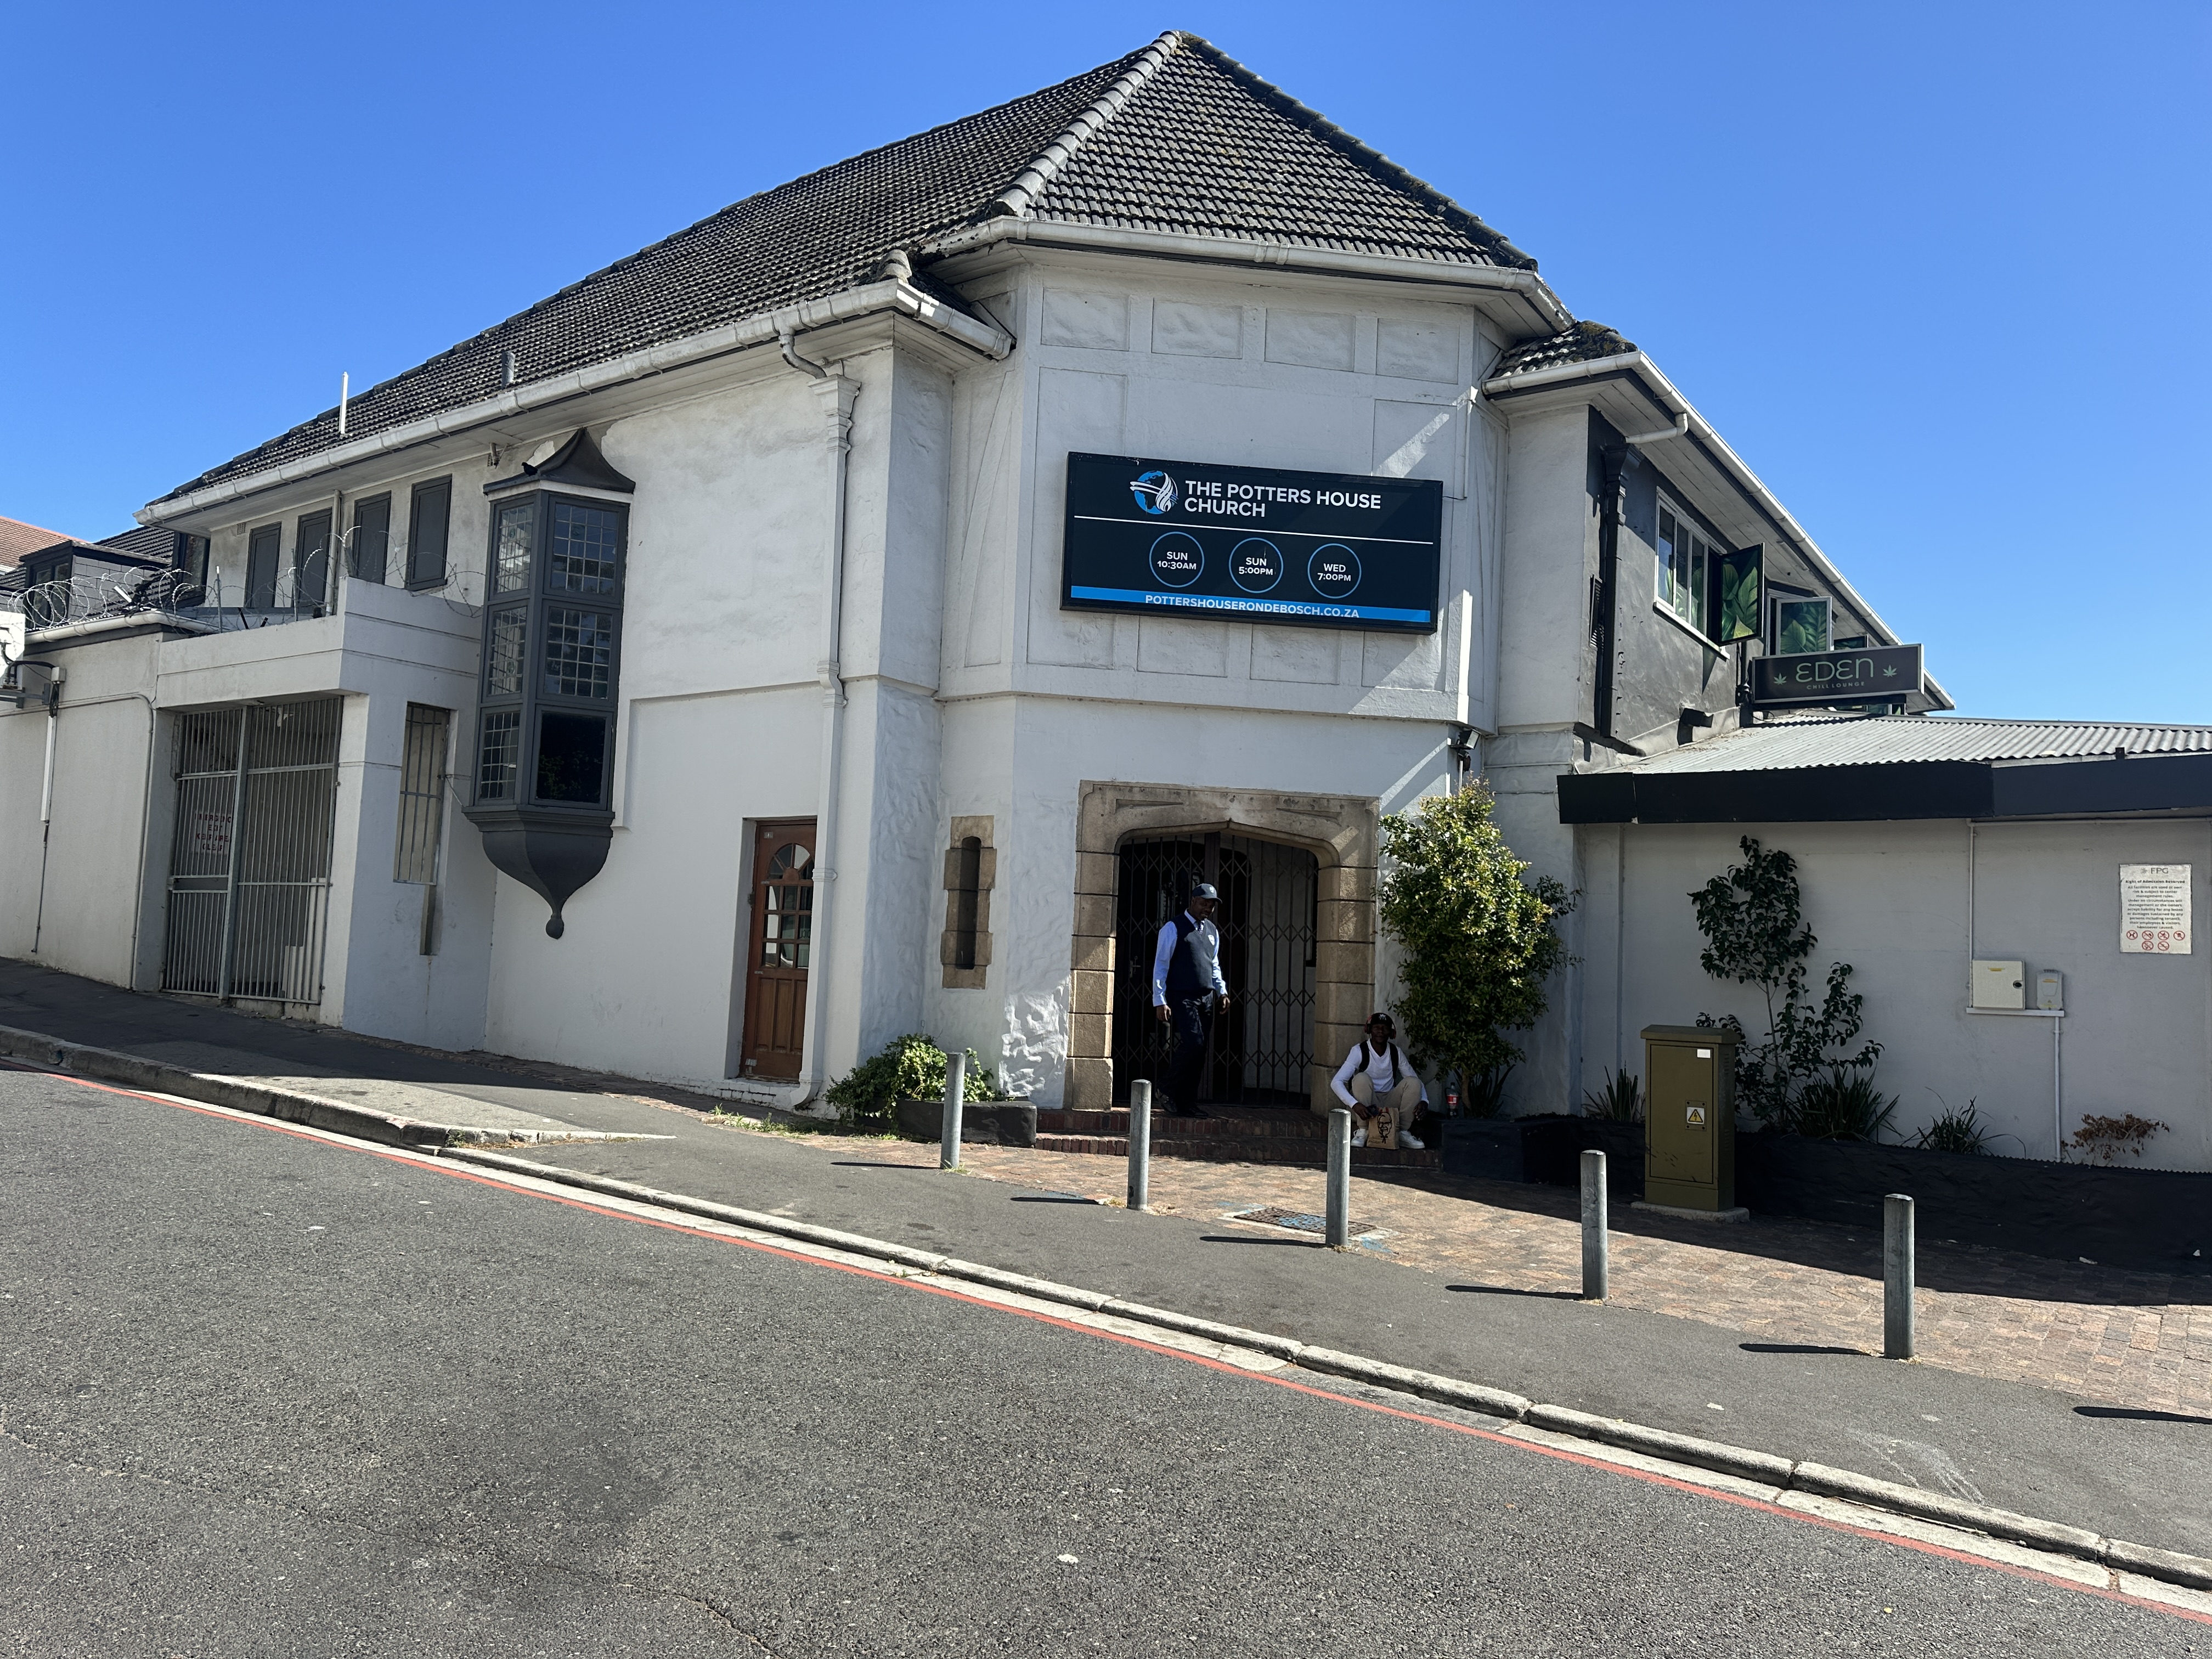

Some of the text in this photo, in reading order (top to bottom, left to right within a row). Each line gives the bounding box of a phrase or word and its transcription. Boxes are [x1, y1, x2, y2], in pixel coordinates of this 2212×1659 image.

[1185, 480, 1381, 509] THE POTTERS HOUSE
[1184, 497, 1265, 517] CHURCH
[1166, 551, 1188, 561] SUN
[1157, 560, 1197, 570] 10:30AM
[1245, 557, 1267, 566] SUN
[1238, 566, 1273, 575] 5:00PM
[1323, 563, 1346, 572] WED
[1317, 573, 1351, 582] 7:00PM
[1145, 595, 1359, 618] POTTERSHOUSERONDEBOSCH.CO.ZA
[1796, 658, 1874, 682] EDEN
